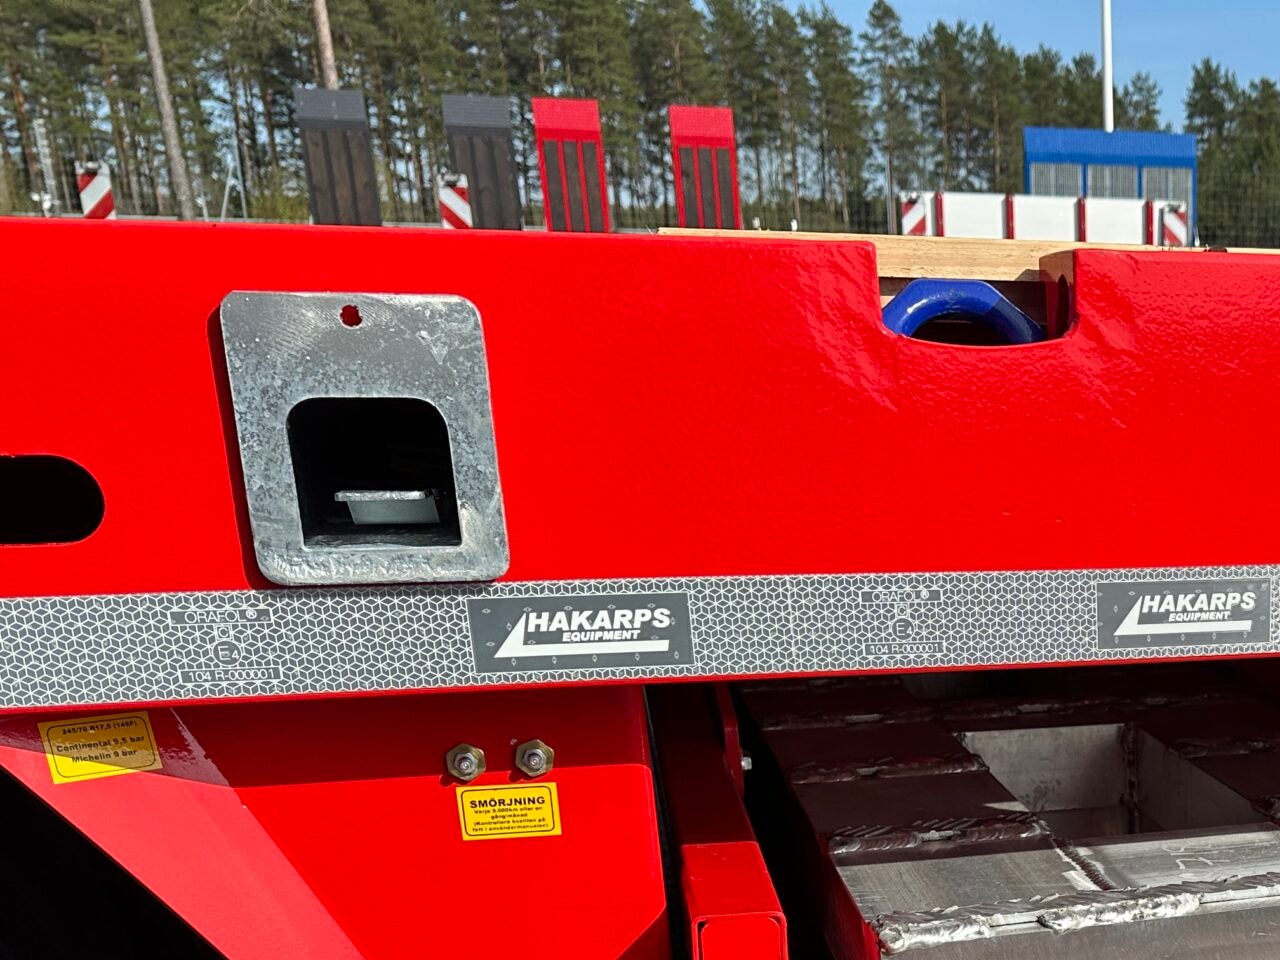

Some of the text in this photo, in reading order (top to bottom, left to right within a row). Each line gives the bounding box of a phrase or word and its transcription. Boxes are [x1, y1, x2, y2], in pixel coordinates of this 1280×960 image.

[1141, 592, 1257, 613] HAKARPS
[527, 608, 671, 633] HAKARPS
[1168, 610, 1232, 622] EQUIPMENT
[562, 629, 641, 643] EQUIPMENT
[188, 671, 212, 682] 104
[56, 735, 145, 752] Continental 9,5 bar
[72, 752, 112, 763] Michelin
[122, 749, 137, 757] bar
[470, 796, 545, 809] SMÖRJNING
